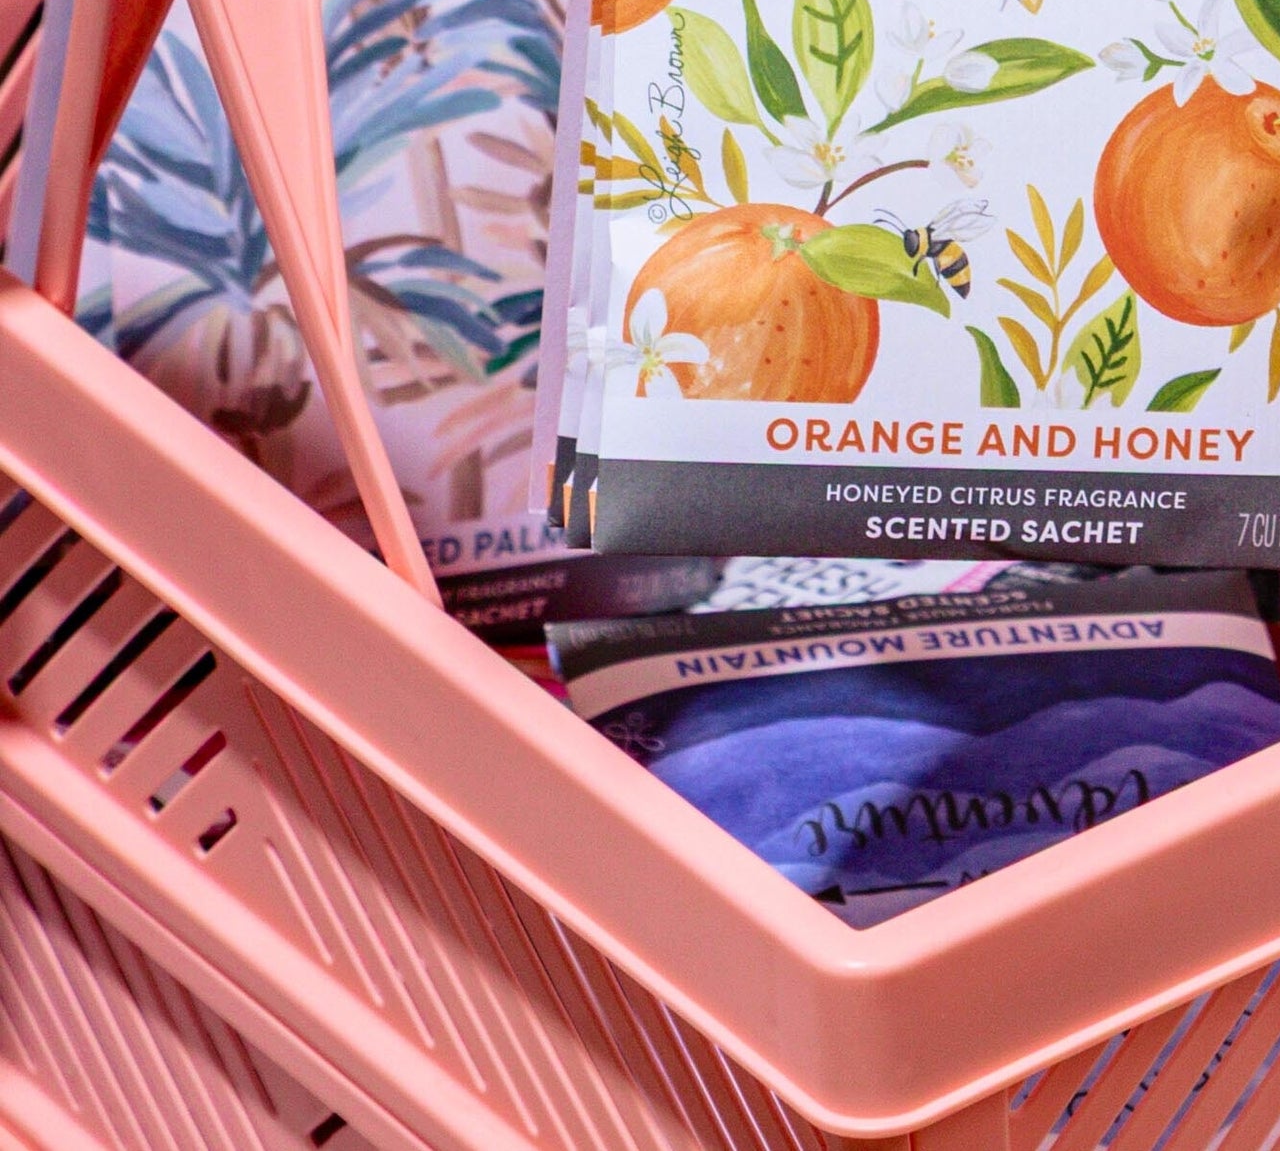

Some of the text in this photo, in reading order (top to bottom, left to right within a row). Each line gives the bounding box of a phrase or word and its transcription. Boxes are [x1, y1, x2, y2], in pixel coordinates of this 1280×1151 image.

[765, 417, 1256, 462] ORANGE AND HONEY
[825, 481, 1188, 510] HONEYED CITRUS FRAGRANCE
[865, 515, 1145, 545] SCENTED SACHET
[1238, 512, 1250, 548] 7
[1252, 513, 1277, 549] CU
[675, 618, 1166, 679] ADVENTURE MOUNTAIN
